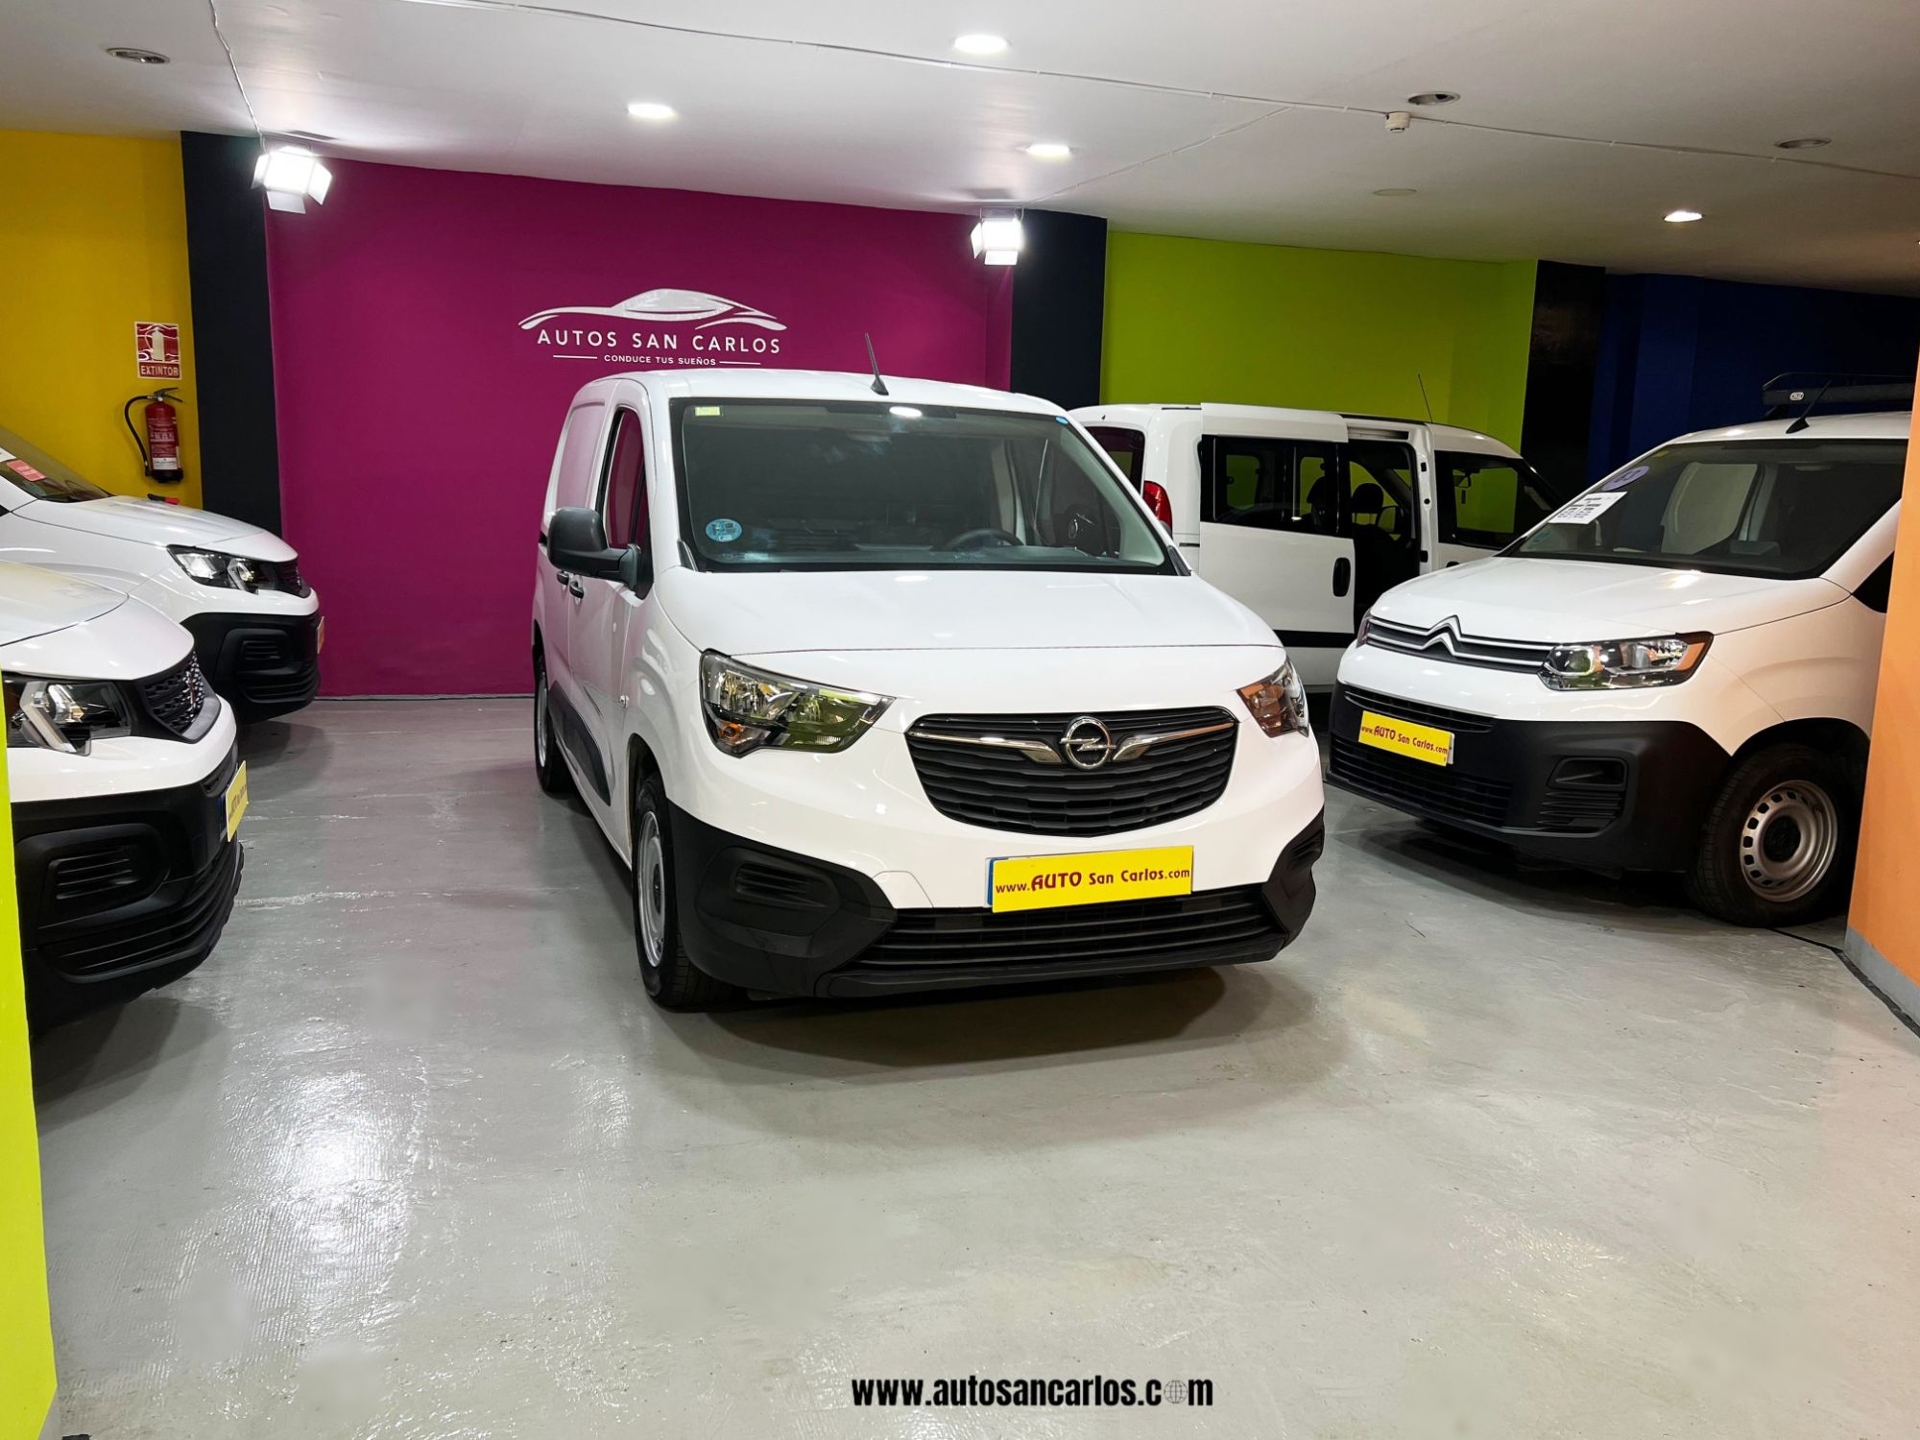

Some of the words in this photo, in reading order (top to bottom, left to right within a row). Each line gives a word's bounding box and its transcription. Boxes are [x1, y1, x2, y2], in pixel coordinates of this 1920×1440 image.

[537, 329, 617, 347] AUTOS
[632, 332, 678, 349] SAN
[692, 335, 780, 354] CARLOS
[604, 354, 652, 365] CONDUCE
[655, 355, 674, 365] TUS
[678, 356, 716, 366] SUEÑOS
[140, 365, 179, 377] EXTINTOR
[1398, 733, 1410, 745] San
[1412, 738, 1448, 754] Carlos.com
[1089, 872, 1114, 886] San
[1121, 868, 1190, 883] Carlos.com
